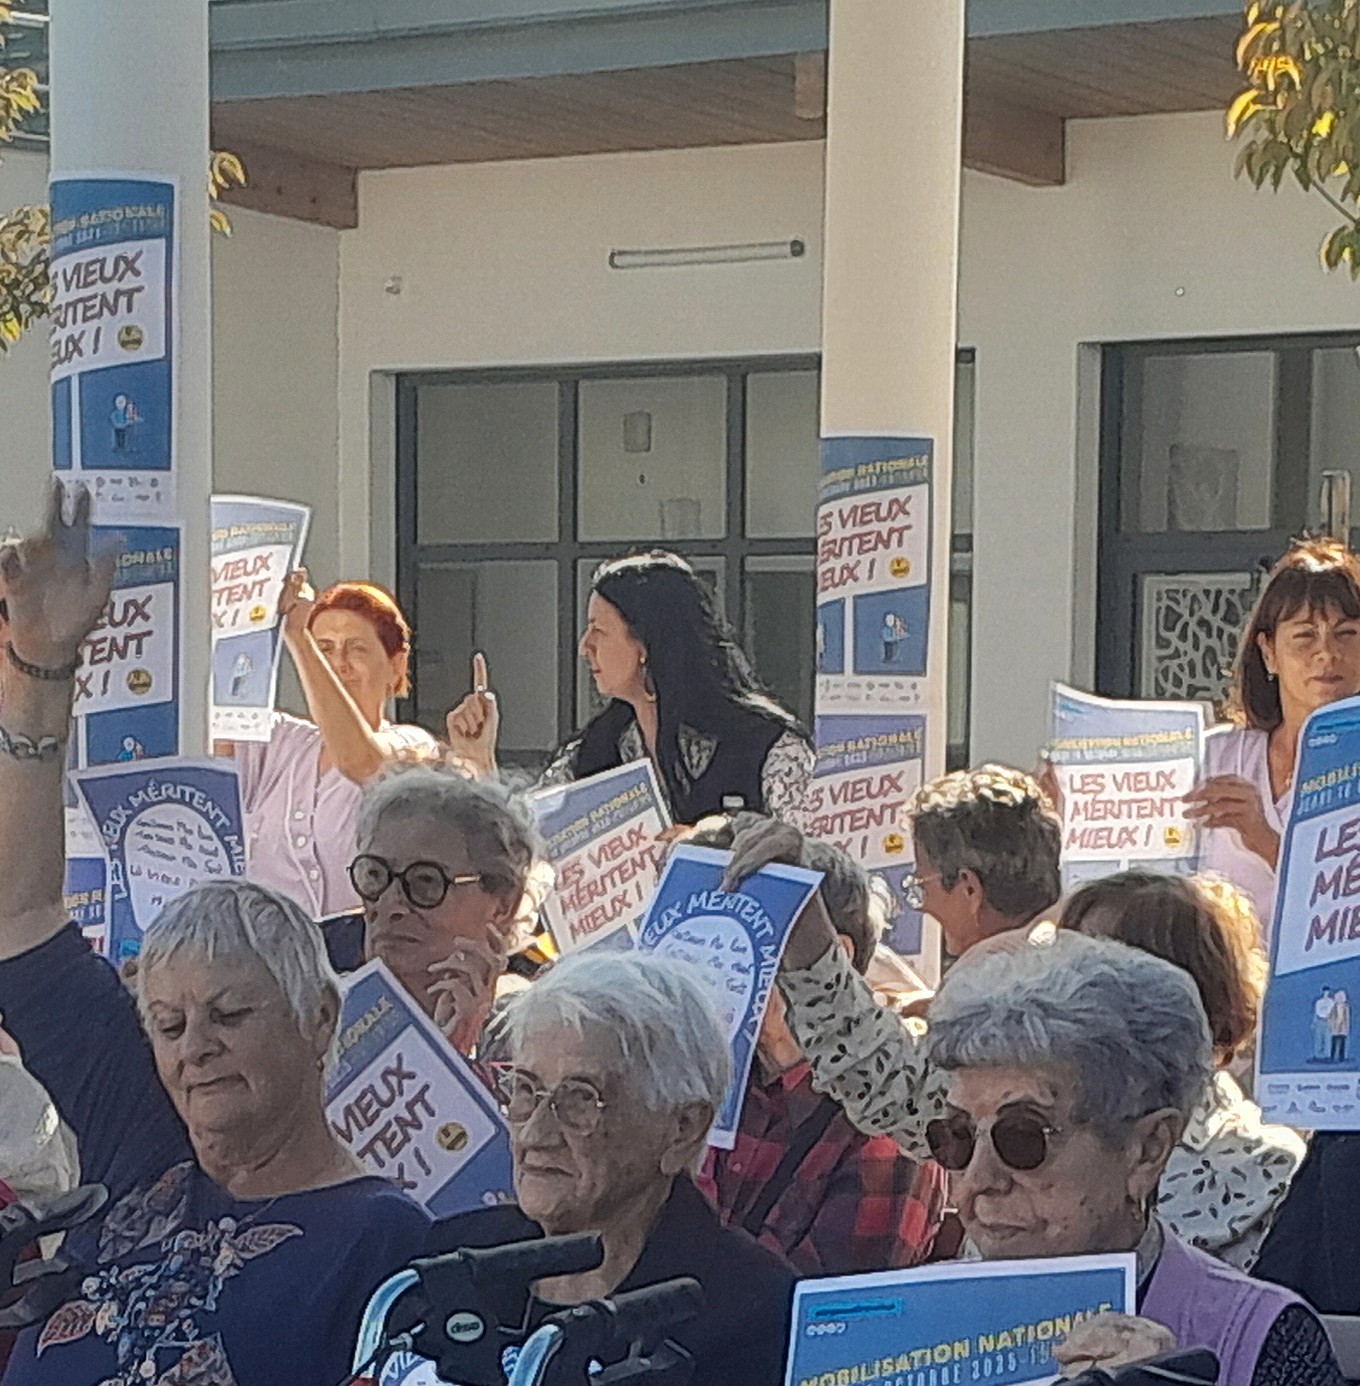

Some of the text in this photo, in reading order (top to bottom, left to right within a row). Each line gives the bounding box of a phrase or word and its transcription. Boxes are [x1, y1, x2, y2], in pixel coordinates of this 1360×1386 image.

[62, 251, 144, 292] VIEUX
[838, 495, 913, 529] VIEUX
[214, 578, 272, 607] TENT
[830, 770, 905, 805] VIEUX
[1070, 769, 1177, 795] LES VIEUX
[128, 778, 231, 829] MÉRITENT
[1070, 795, 1184, 823] MÉRITENT
[1065, 825, 1139, 850] MIEUX
[554, 822, 648, 892] LES VIEUX
[569, 889, 633, 944] MIEUX
[331, 1053, 418, 1144] VIEUX
[356, 1083, 436, 1170] TENT
